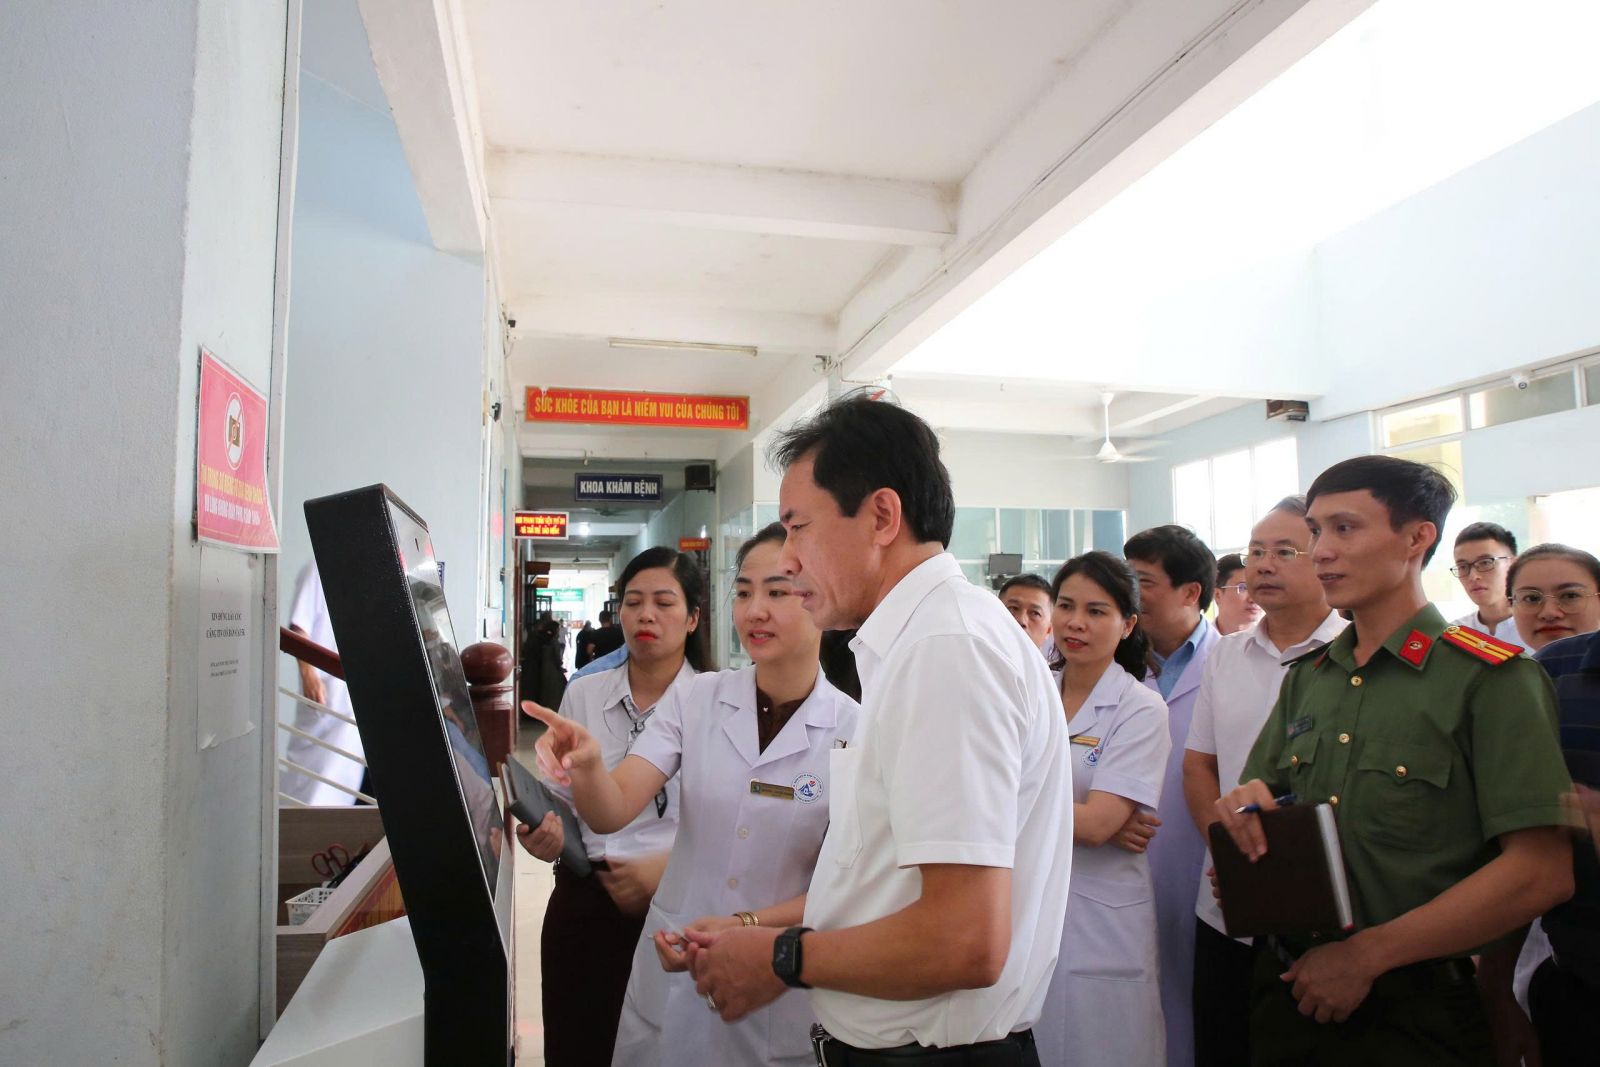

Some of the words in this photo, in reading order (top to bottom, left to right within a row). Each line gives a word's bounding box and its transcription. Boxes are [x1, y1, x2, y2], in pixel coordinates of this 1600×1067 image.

[581, 394, 599, 415] CỦA
[601, 399, 619, 419] BẠN
[622, 397, 632, 416] LÀ
[660, 402, 673, 418] VUI
[676, 397, 693, 419] CỦA
[696, 401, 724, 420] CHÚNG
[727, 403, 740, 421] TÔI
[580, 481, 604, 493] KHOA
[606, 479, 632, 494] KHÁM
[634, 480, 658, 497] BỆNH
